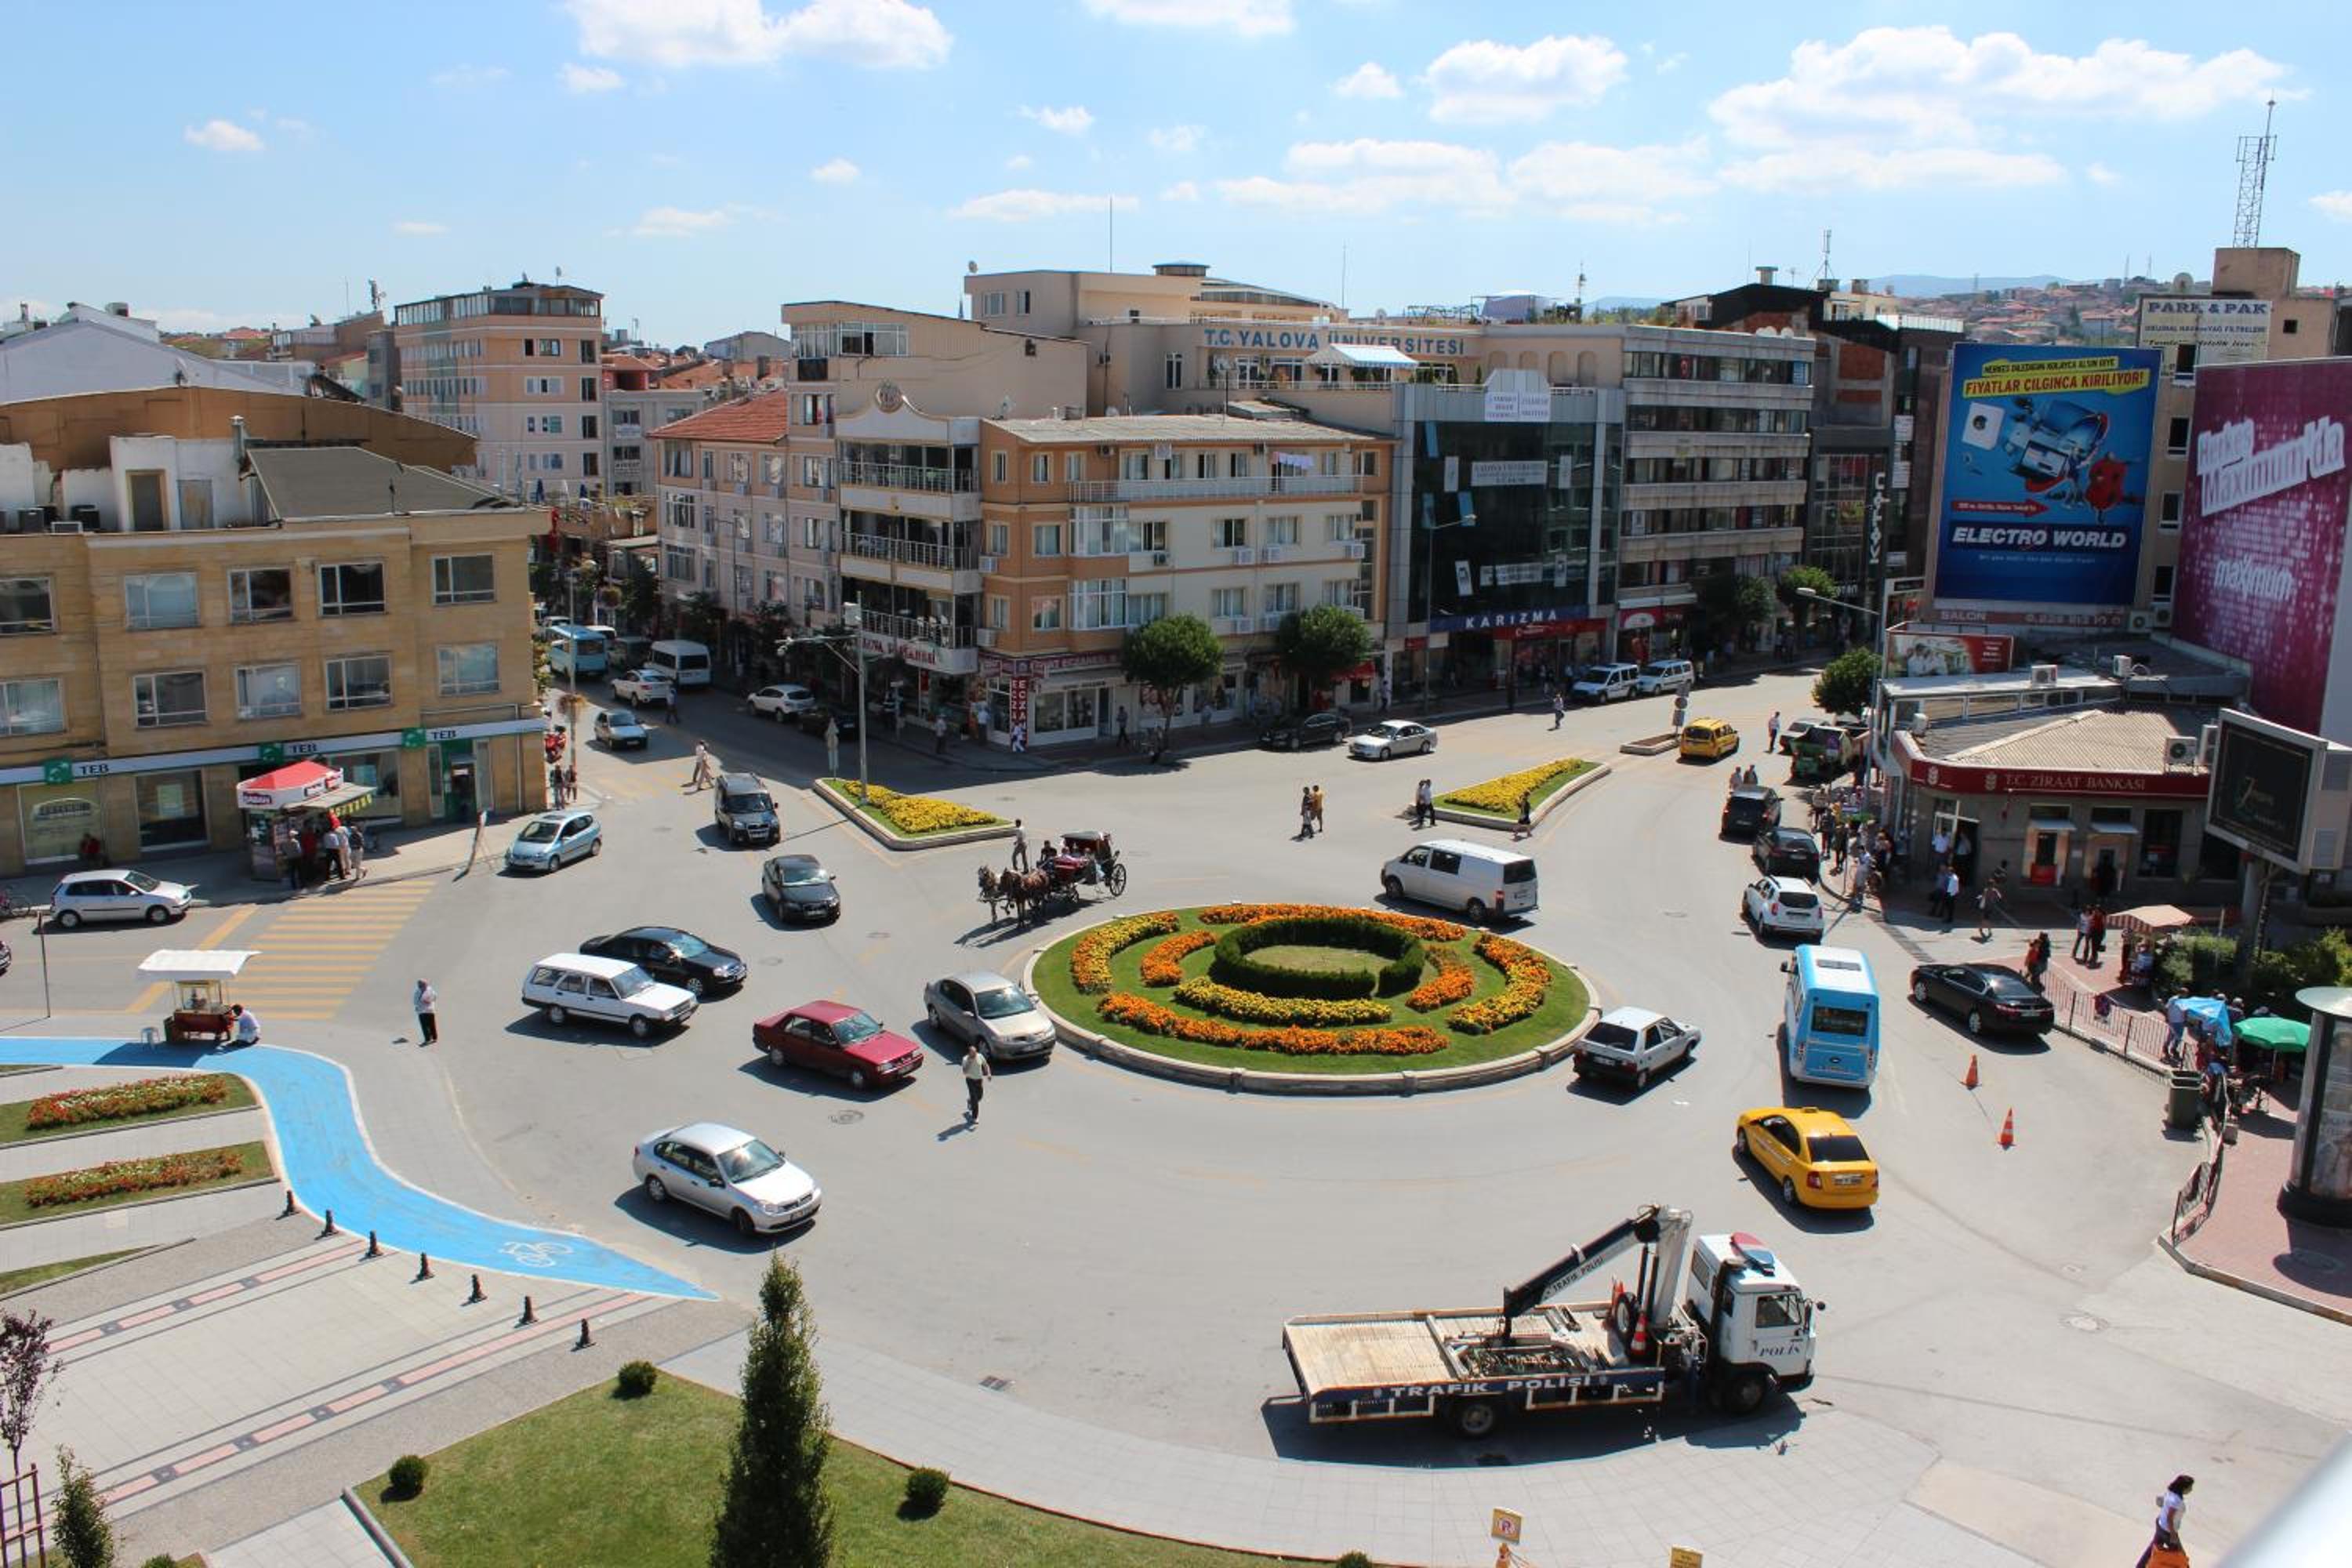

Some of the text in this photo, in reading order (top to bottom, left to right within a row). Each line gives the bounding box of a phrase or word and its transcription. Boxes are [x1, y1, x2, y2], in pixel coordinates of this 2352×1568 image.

[2148, 302, 2267, 314] PARK & PAK
[1203, 328, 1235, 346] T.C.
[1239, 331, 1319, 350] YALOVA
[1952, 526, 2127, 548] ELECTRO WORLD
[431, 729, 457, 741] TEB
[291, 743, 318, 754] TEB
[79, 763, 110, 775] TEB
